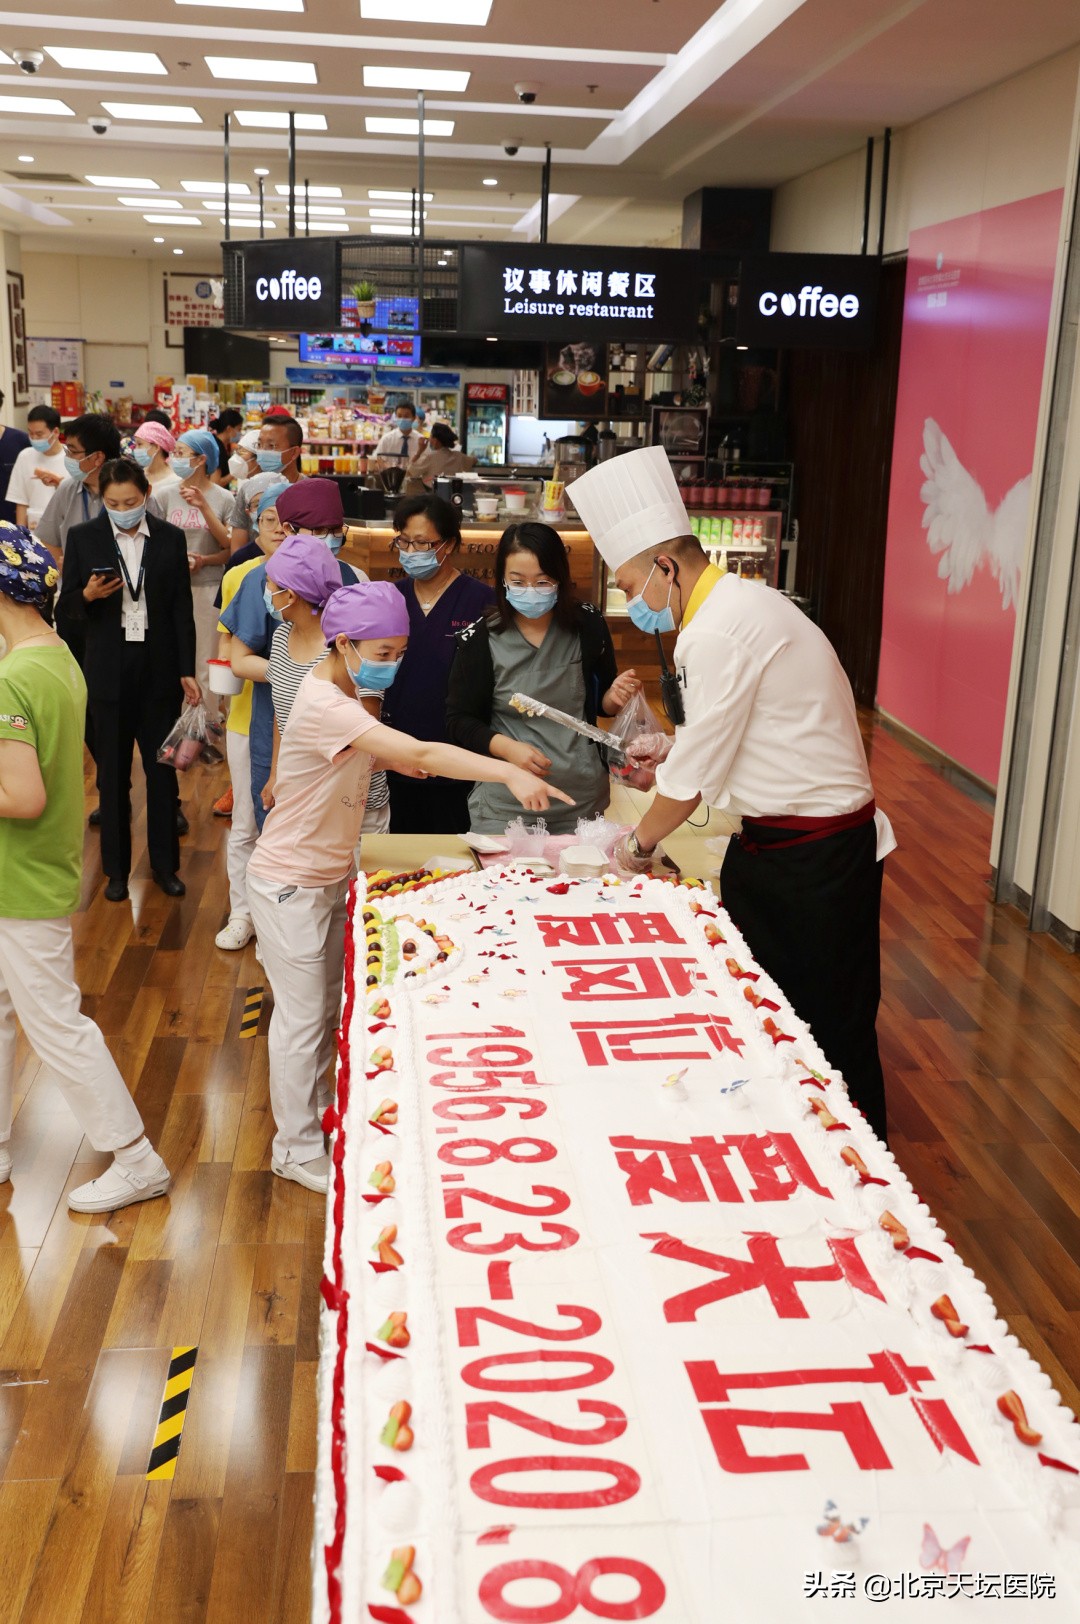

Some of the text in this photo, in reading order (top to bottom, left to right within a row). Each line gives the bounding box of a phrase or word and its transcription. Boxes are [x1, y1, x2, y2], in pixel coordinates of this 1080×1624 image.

[503, 268, 656, 299] 议事休闲餐区
[504, 298, 654, 319] Leisure restaurant
[171, 508, 210, 530] GA
[534, 911, 746, 1066] 爱岗位
[608, 1131, 981, 1476] 爱天坛
